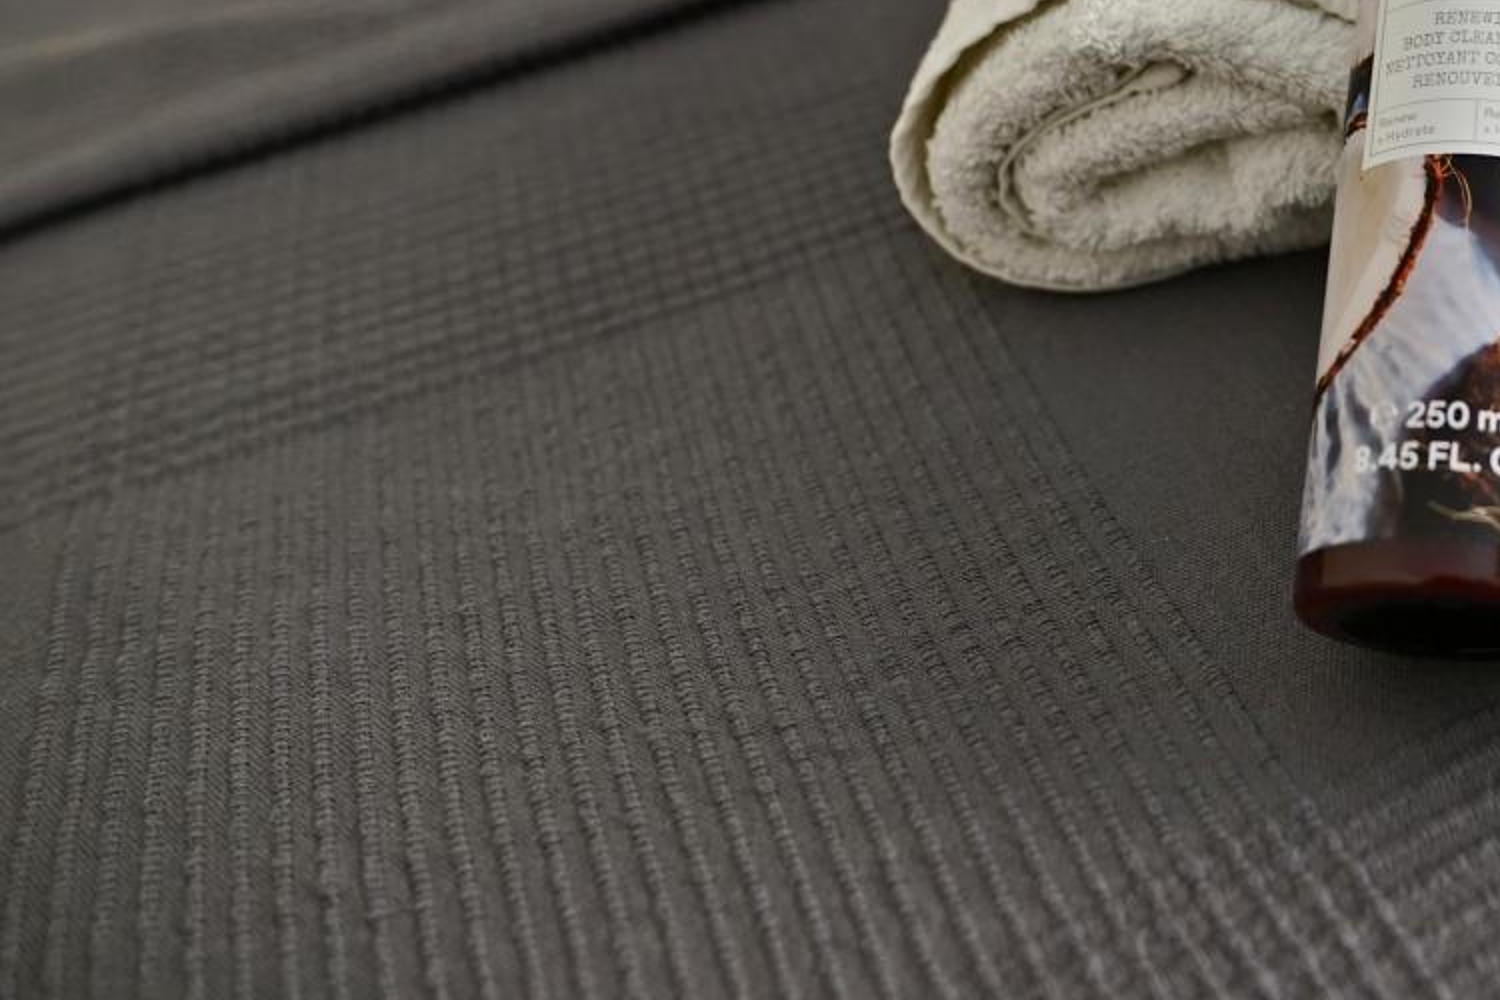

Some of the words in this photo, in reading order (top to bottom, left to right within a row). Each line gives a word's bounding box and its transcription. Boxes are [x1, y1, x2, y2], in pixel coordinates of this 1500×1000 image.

[1403, 29, 1443, 51] BODY
[1386, 50, 1478, 75] NETTOYANT
[1405, 400, 1470, 429] 250
[1428, 442, 1482, 473] FL.
